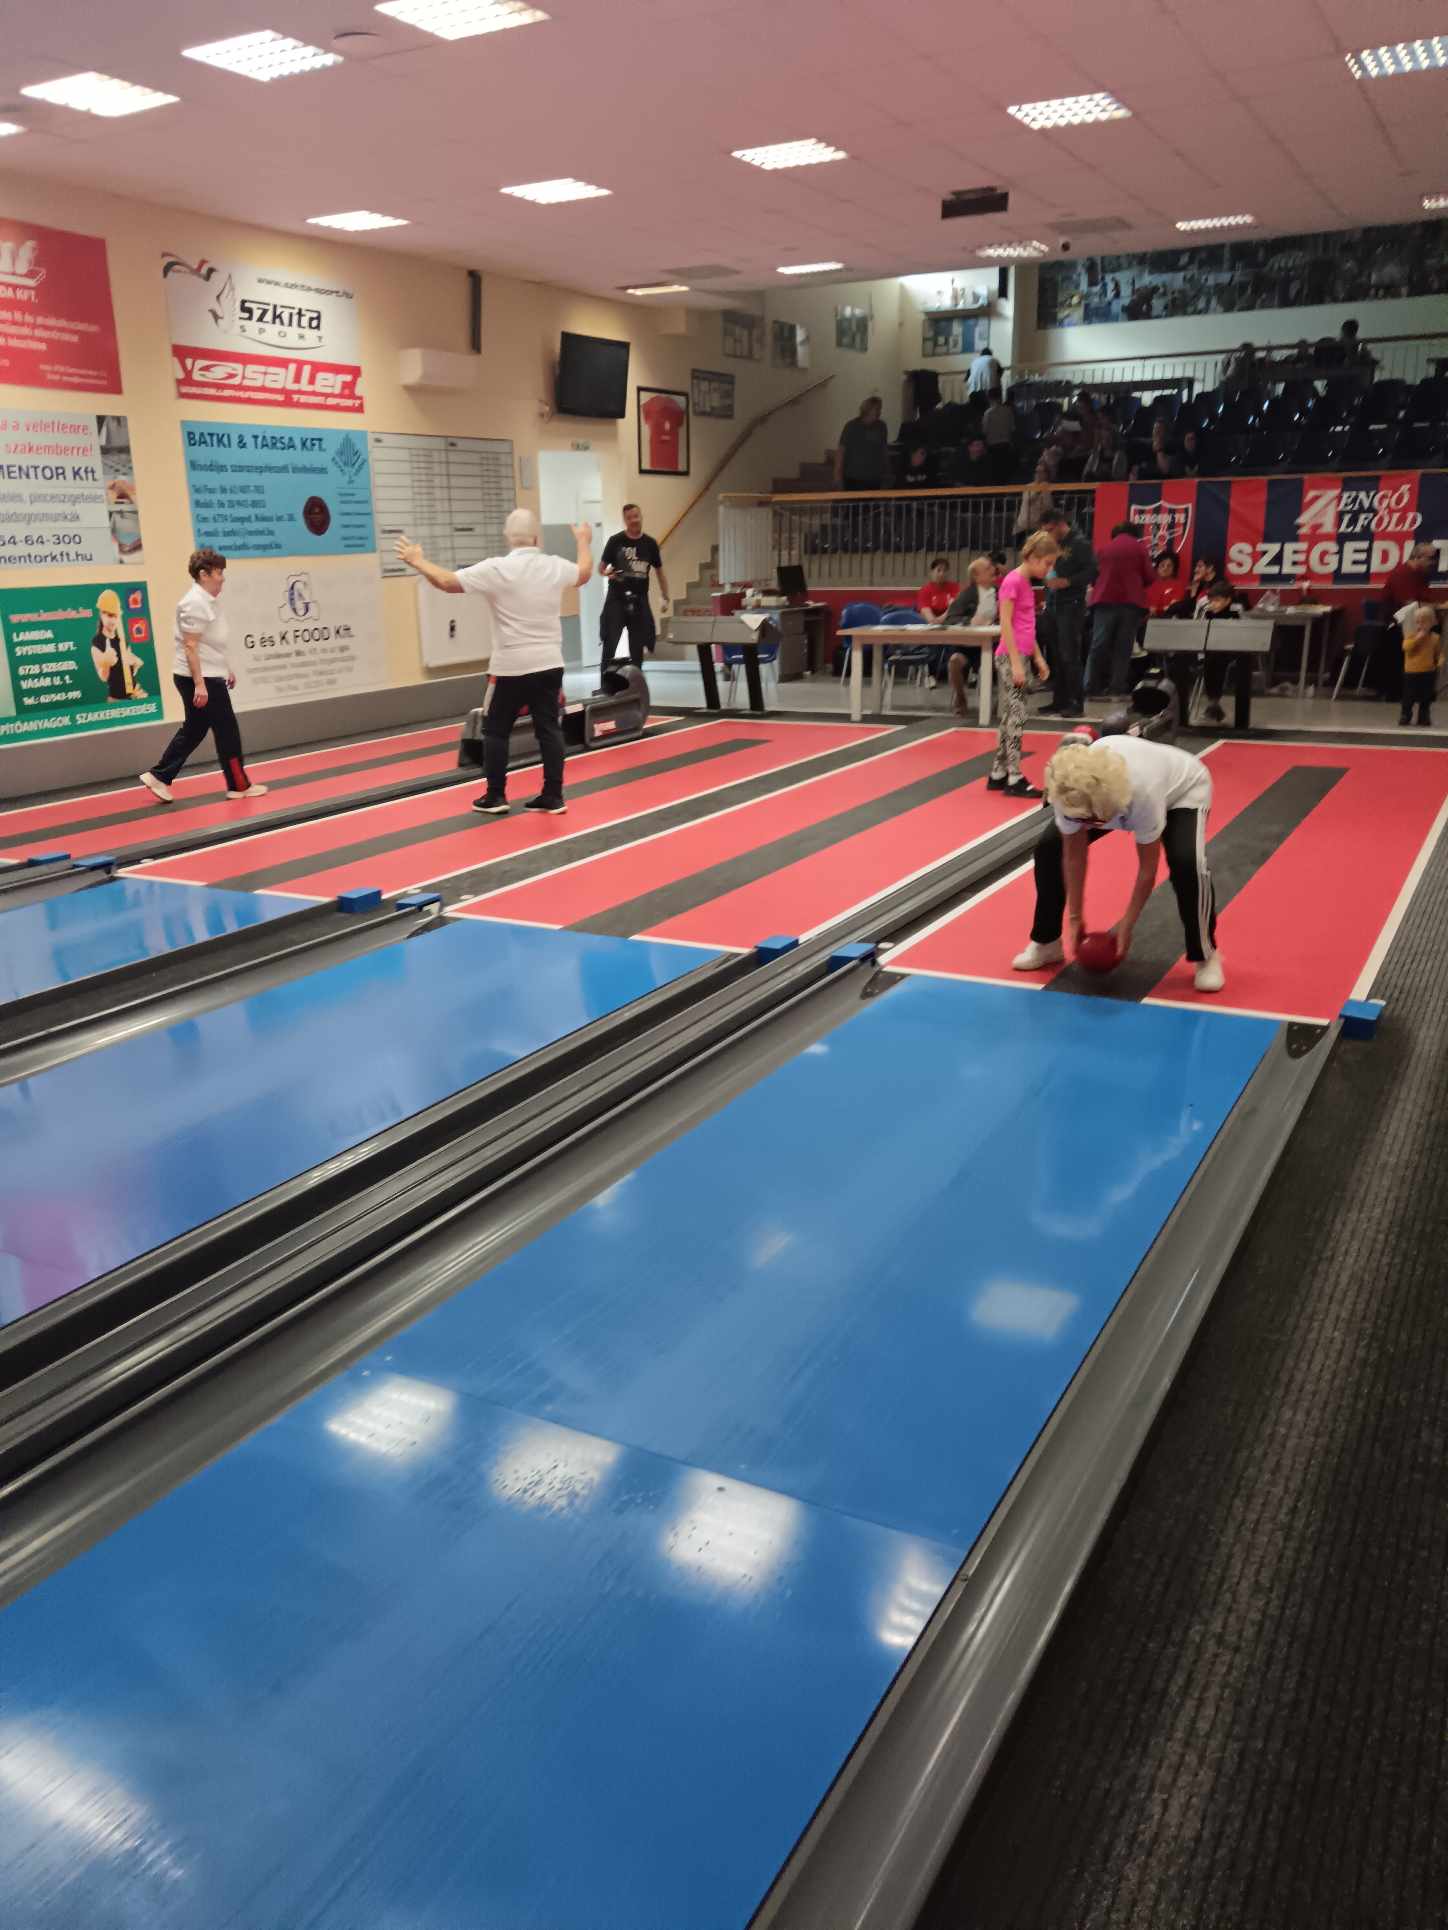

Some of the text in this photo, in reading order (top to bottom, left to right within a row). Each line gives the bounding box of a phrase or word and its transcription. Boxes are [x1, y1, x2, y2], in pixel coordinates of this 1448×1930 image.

[187, 430, 327, 453] BATKI & TÁRSA KFT.
[12, 629, 54, 642] LAMBDA
[244, 634, 255, 649] G
[280, 630, 289, 645] K
[293, 626, 330, 644] FOOD
